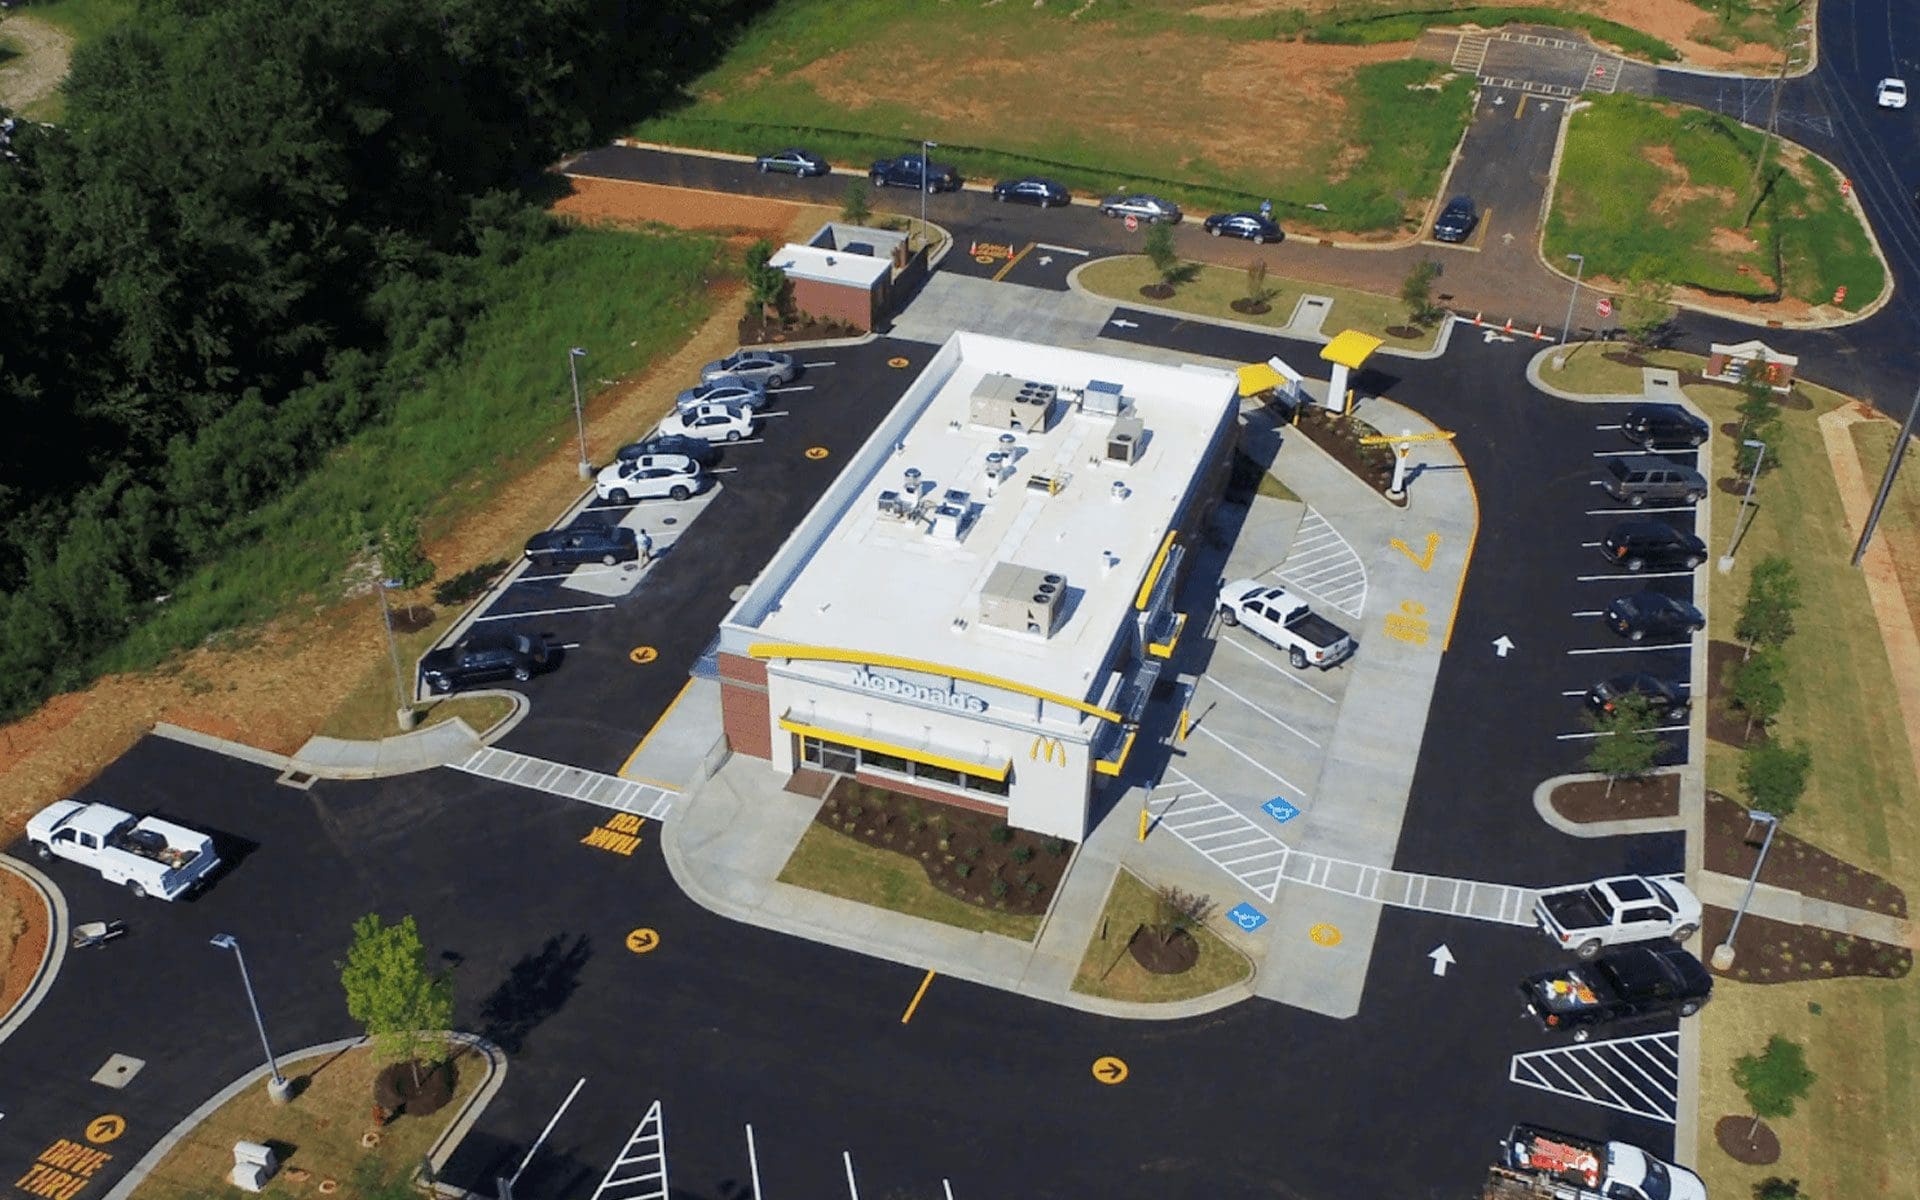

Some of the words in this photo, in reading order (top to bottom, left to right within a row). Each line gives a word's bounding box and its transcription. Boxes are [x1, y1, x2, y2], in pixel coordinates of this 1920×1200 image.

[851, 670, 985, 712] McDonald's
[38, 1139, 112, 1176] DRIVE
[15, 1164, 89, 1200] THRU
